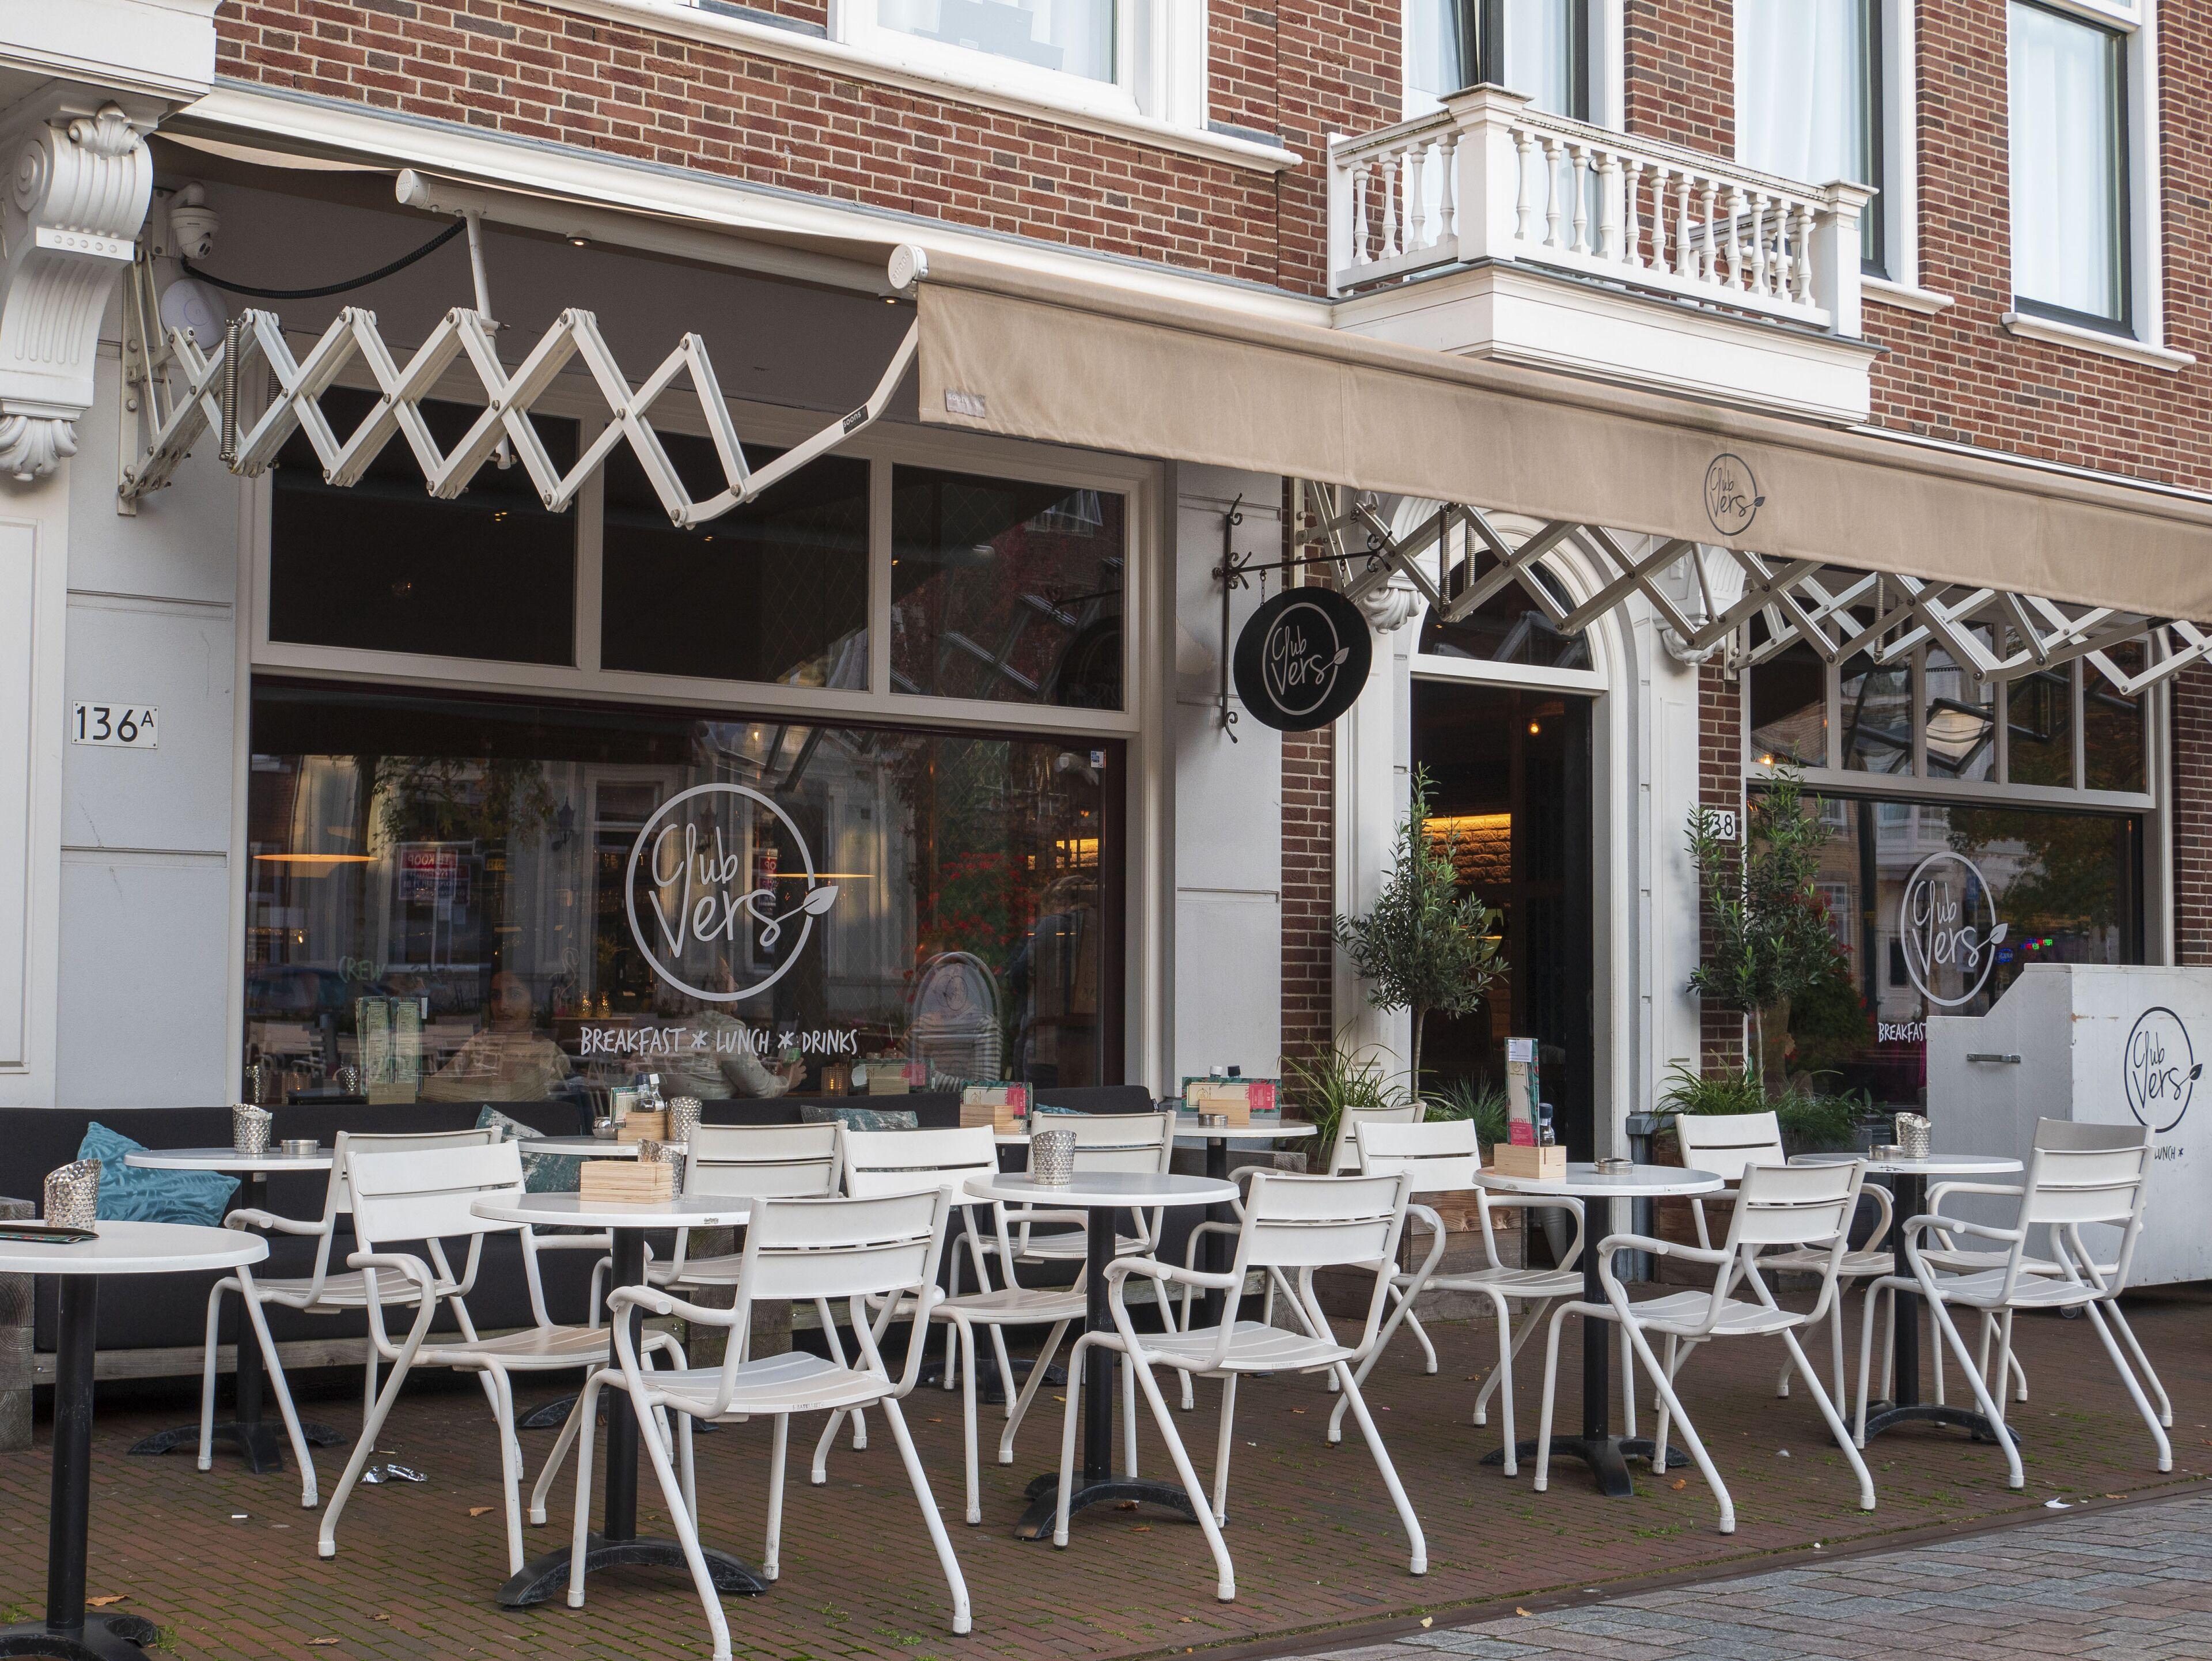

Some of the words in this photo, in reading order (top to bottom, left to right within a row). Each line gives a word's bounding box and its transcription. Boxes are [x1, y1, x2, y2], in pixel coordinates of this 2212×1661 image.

[843, 411, 861, 427] soons
[1710, 467, 1734, 491] Club
[1710, 491, 1747, 517] Vers
[1272, 626, 1306, 661] Club
[1271, 654, 1325, 695] Vers
[652, 823, 738, 887] Club
[1913, 880, 1956, 926] Club
[649, 890, 781, 957] Vers
[1912, 926, 1979, 976] Vers
[581, 1027, 686, 1055] BREAKFAST
[717, 1028, 768, 1055] LUNCH
[802, 1029, 858, 1055] DRINKS
[2133, 1030, 2165, 1068] Club
[2133, 1067, 2181, 1108] Vers
